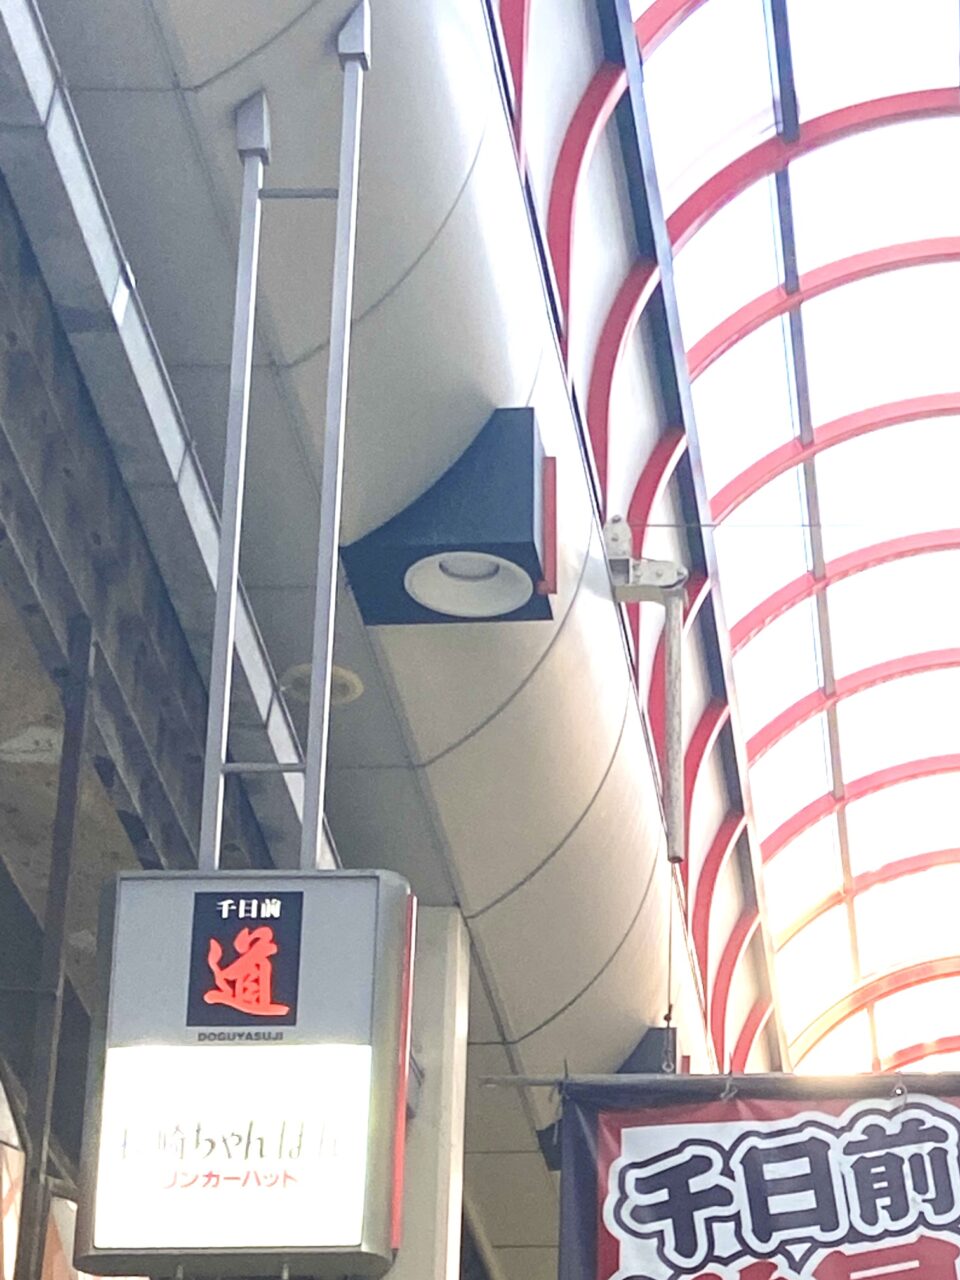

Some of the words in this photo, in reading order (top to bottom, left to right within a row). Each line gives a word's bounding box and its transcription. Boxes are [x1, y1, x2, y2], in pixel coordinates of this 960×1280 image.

[215, 898, 282, 921] 千日前
[203, 925, 290, 1016] 道
[197, 1031, 284, 1042] DOGUYASUJI
[626, 1118, 960, 1259] 千日前
